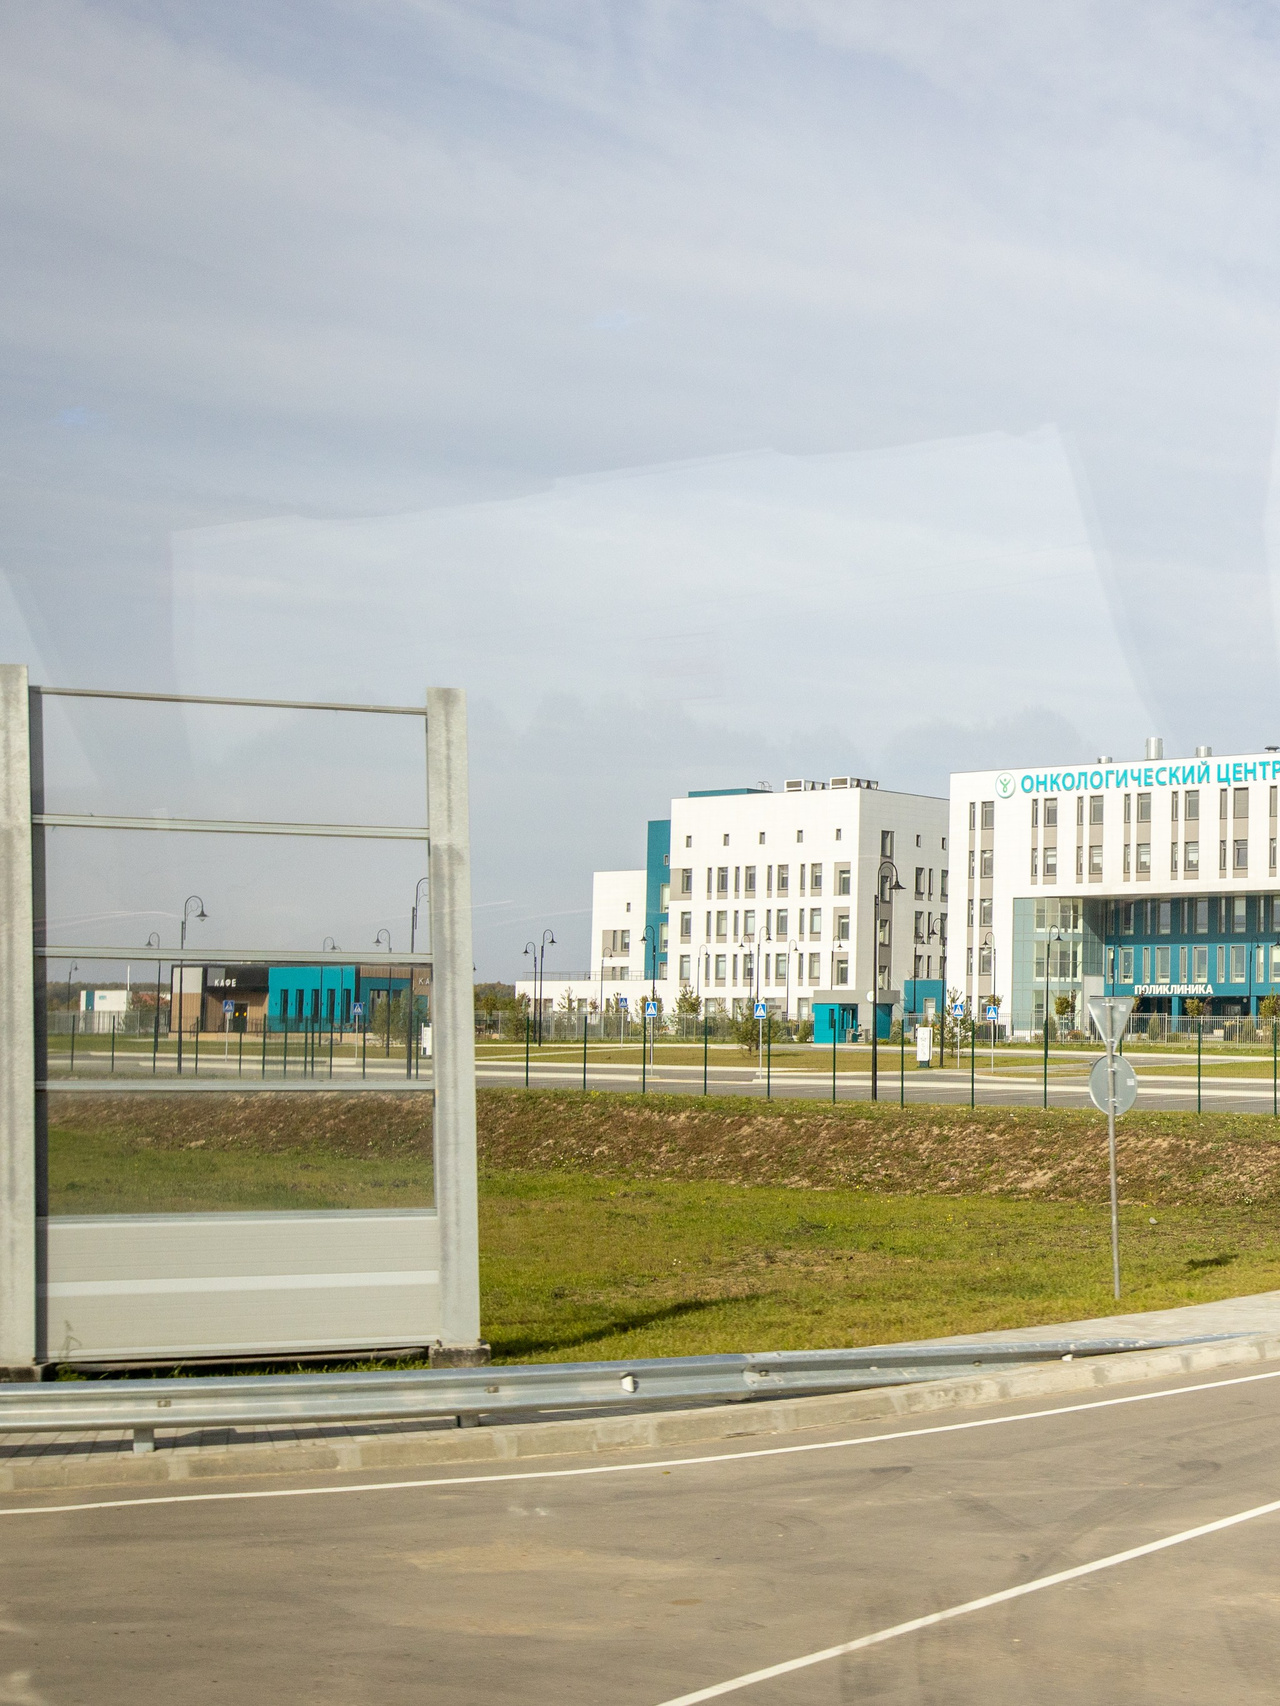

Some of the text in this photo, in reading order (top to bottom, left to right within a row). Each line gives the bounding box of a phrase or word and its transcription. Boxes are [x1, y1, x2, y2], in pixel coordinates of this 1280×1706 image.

[1020, 760, 1210, 793] ОНКОЛОГИЧЕСКИЙ
[214, 978, 237, 987] КАФЕ
[1134, 984, 1214, 995] ПОЛИКЛИНИКА
